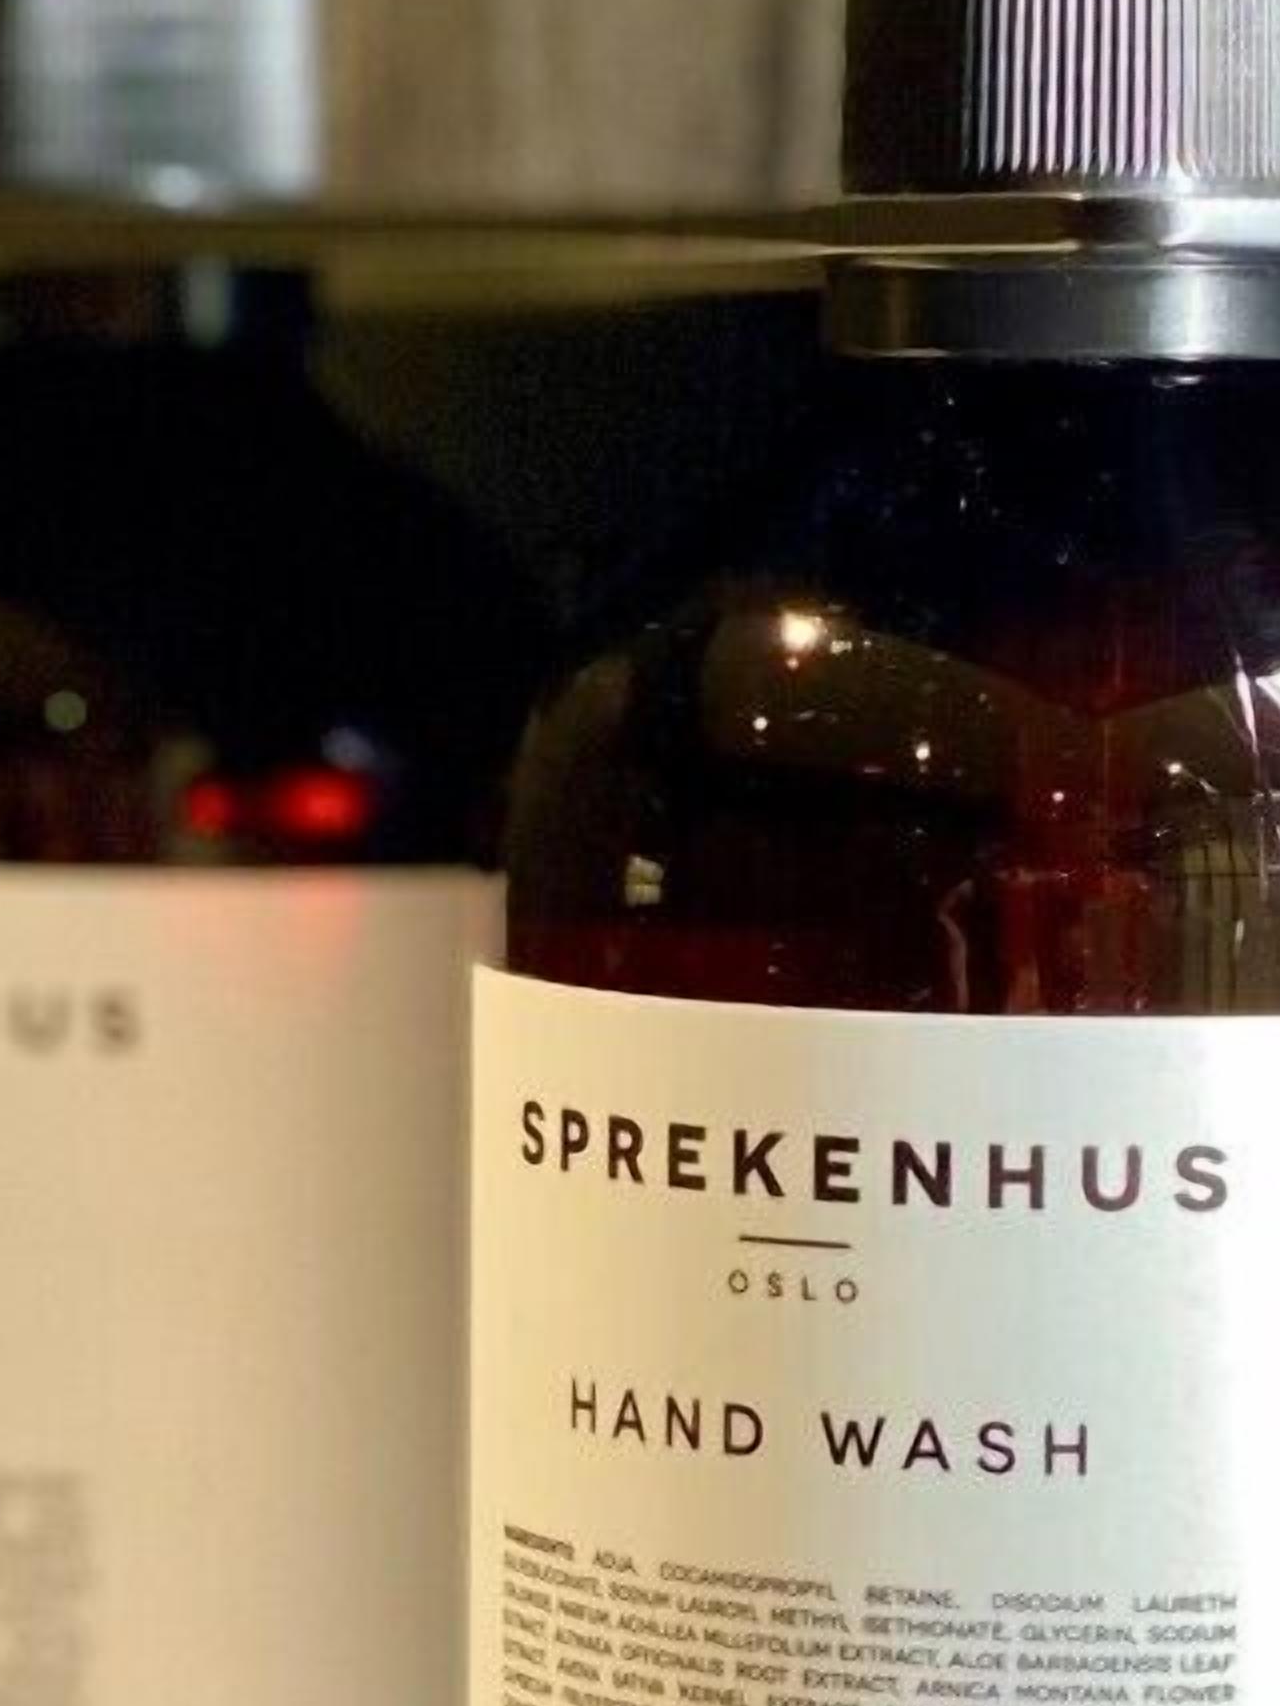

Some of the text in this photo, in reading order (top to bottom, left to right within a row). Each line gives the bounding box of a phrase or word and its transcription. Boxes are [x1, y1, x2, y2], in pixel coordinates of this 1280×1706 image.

[520, 1100, 1230, 1213] SPREKENHUS
[728, 1268, 859, 1304] OSLO
[570, 1375, 1089, 1477] HAND WASH
